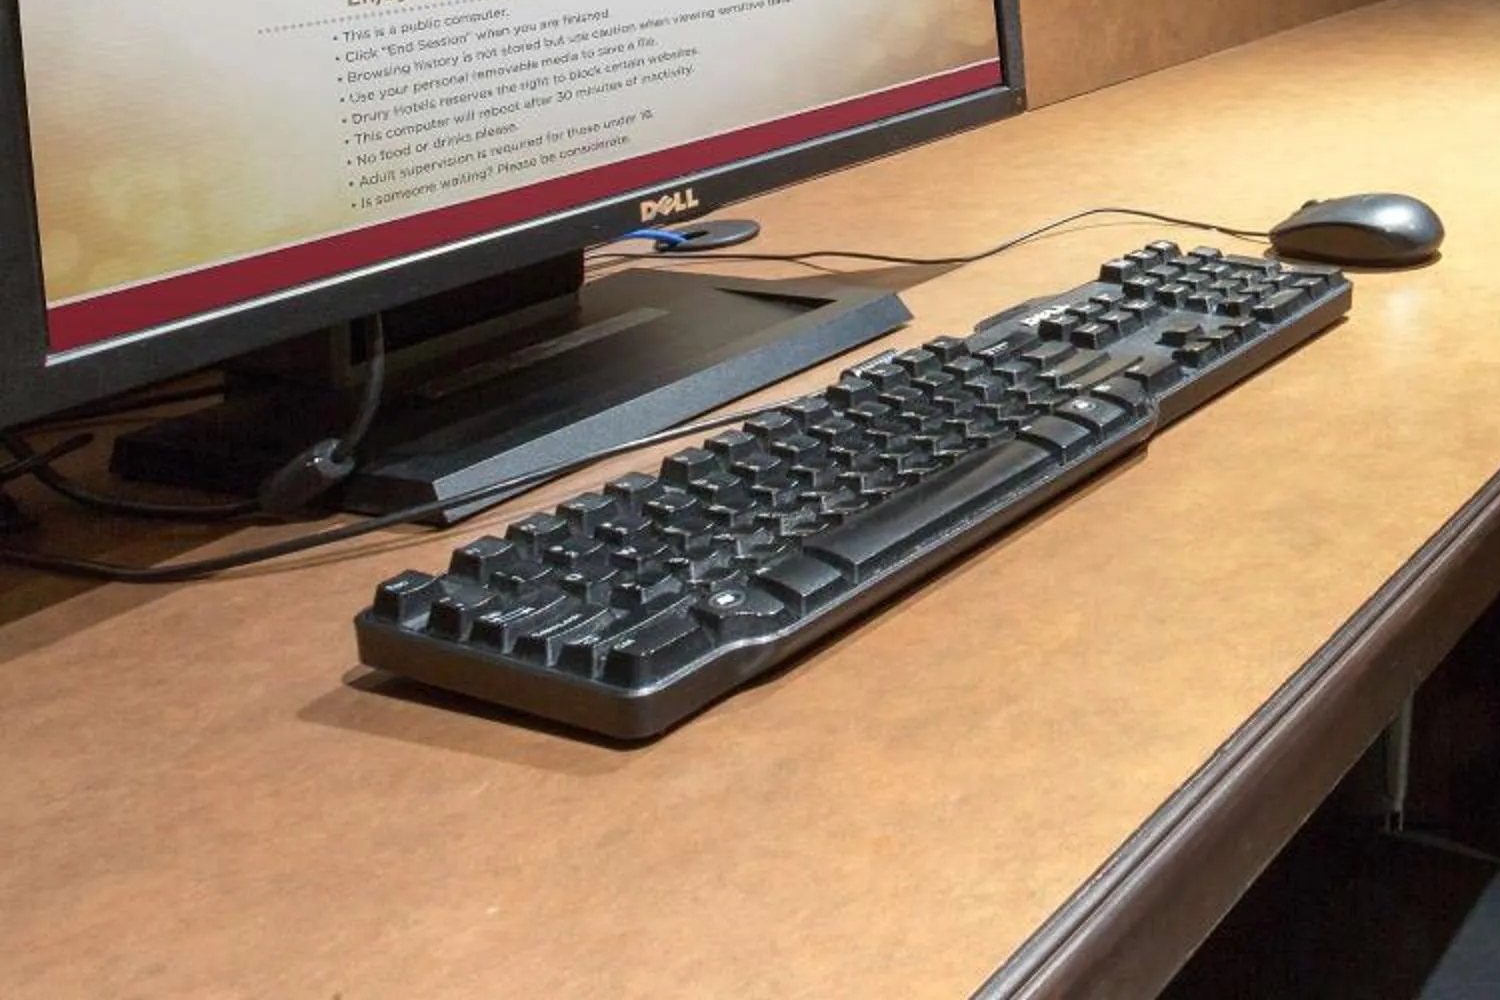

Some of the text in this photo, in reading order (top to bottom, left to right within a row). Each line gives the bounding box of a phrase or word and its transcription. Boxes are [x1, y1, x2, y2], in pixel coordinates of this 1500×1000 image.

[343, 8, 510, 42] This is a public computer.
[345, 47, 377, 63] Click
[475, 26, 511, 41] when
[513, 23, 537, 36] you
[540, 19, 558, 30] are
[347, 62, 411, 83] Browsing
[414, 54, 459, 71] history
[463, 52, 472, 62] is
[476, 47, 497, 60] not
[500, 39, 541, 56] stored
[544, 34, 564, 47] but
[591, 20, 638, 40] caution
[640, 16, 674, 30] when
[674, 8, 715, 25] viewing
[718, 0, 765, 16] sensitive
[349, 90, 374, 104] Use
[378, 85, 409, 101] your
[413, 74, 469, 94] personal
[472, 59, 539, 81] removable
[541, 49, 579, 66] media
[582, 48, 595, 59] to
[598, 44, 624, 56] save
[627, 41, 635, 50] a
[352, 108, 390, 125] Drury
[394, 100, 436, 116] Hotels
[439, 89, 493, 107] reserves
[498, 82, 517, 95] the
[520, 77, 549, 93] right
[553, 73, 567, 85] to
[569, 66, 601, 81] block
[605, 57, 646, 73] certain
[354, 132, 382, 145] This
[385, 117, 450, 139] computer
[453, 111, 475, 124] will
[480, 101, 522, 119] reboot
[524, 95, 552, 109] after
[557, 89, 573, 103] 30
[575, 81, 623, 98] minutes
[625, 75, 638, 87] of
[357, 122, 519, 167] No food or drinks please.
[359, 169, 396, 188] Adult
[400, 151, 474, 179] supervision
[477, 148, 487, 160] is
[491, 134, 543, 158] required
[547, 130, 565, 143] for
[603, 114, 637, 130] under
[361, 197, 372, 209] Is
[376, 183, 438, 205] someone
[440, 166, 492, 189] waiting?
[498, 156, 537, 174] Please
[541, 153, 556, 166] be
[639, 187, 700, 223] DELL
